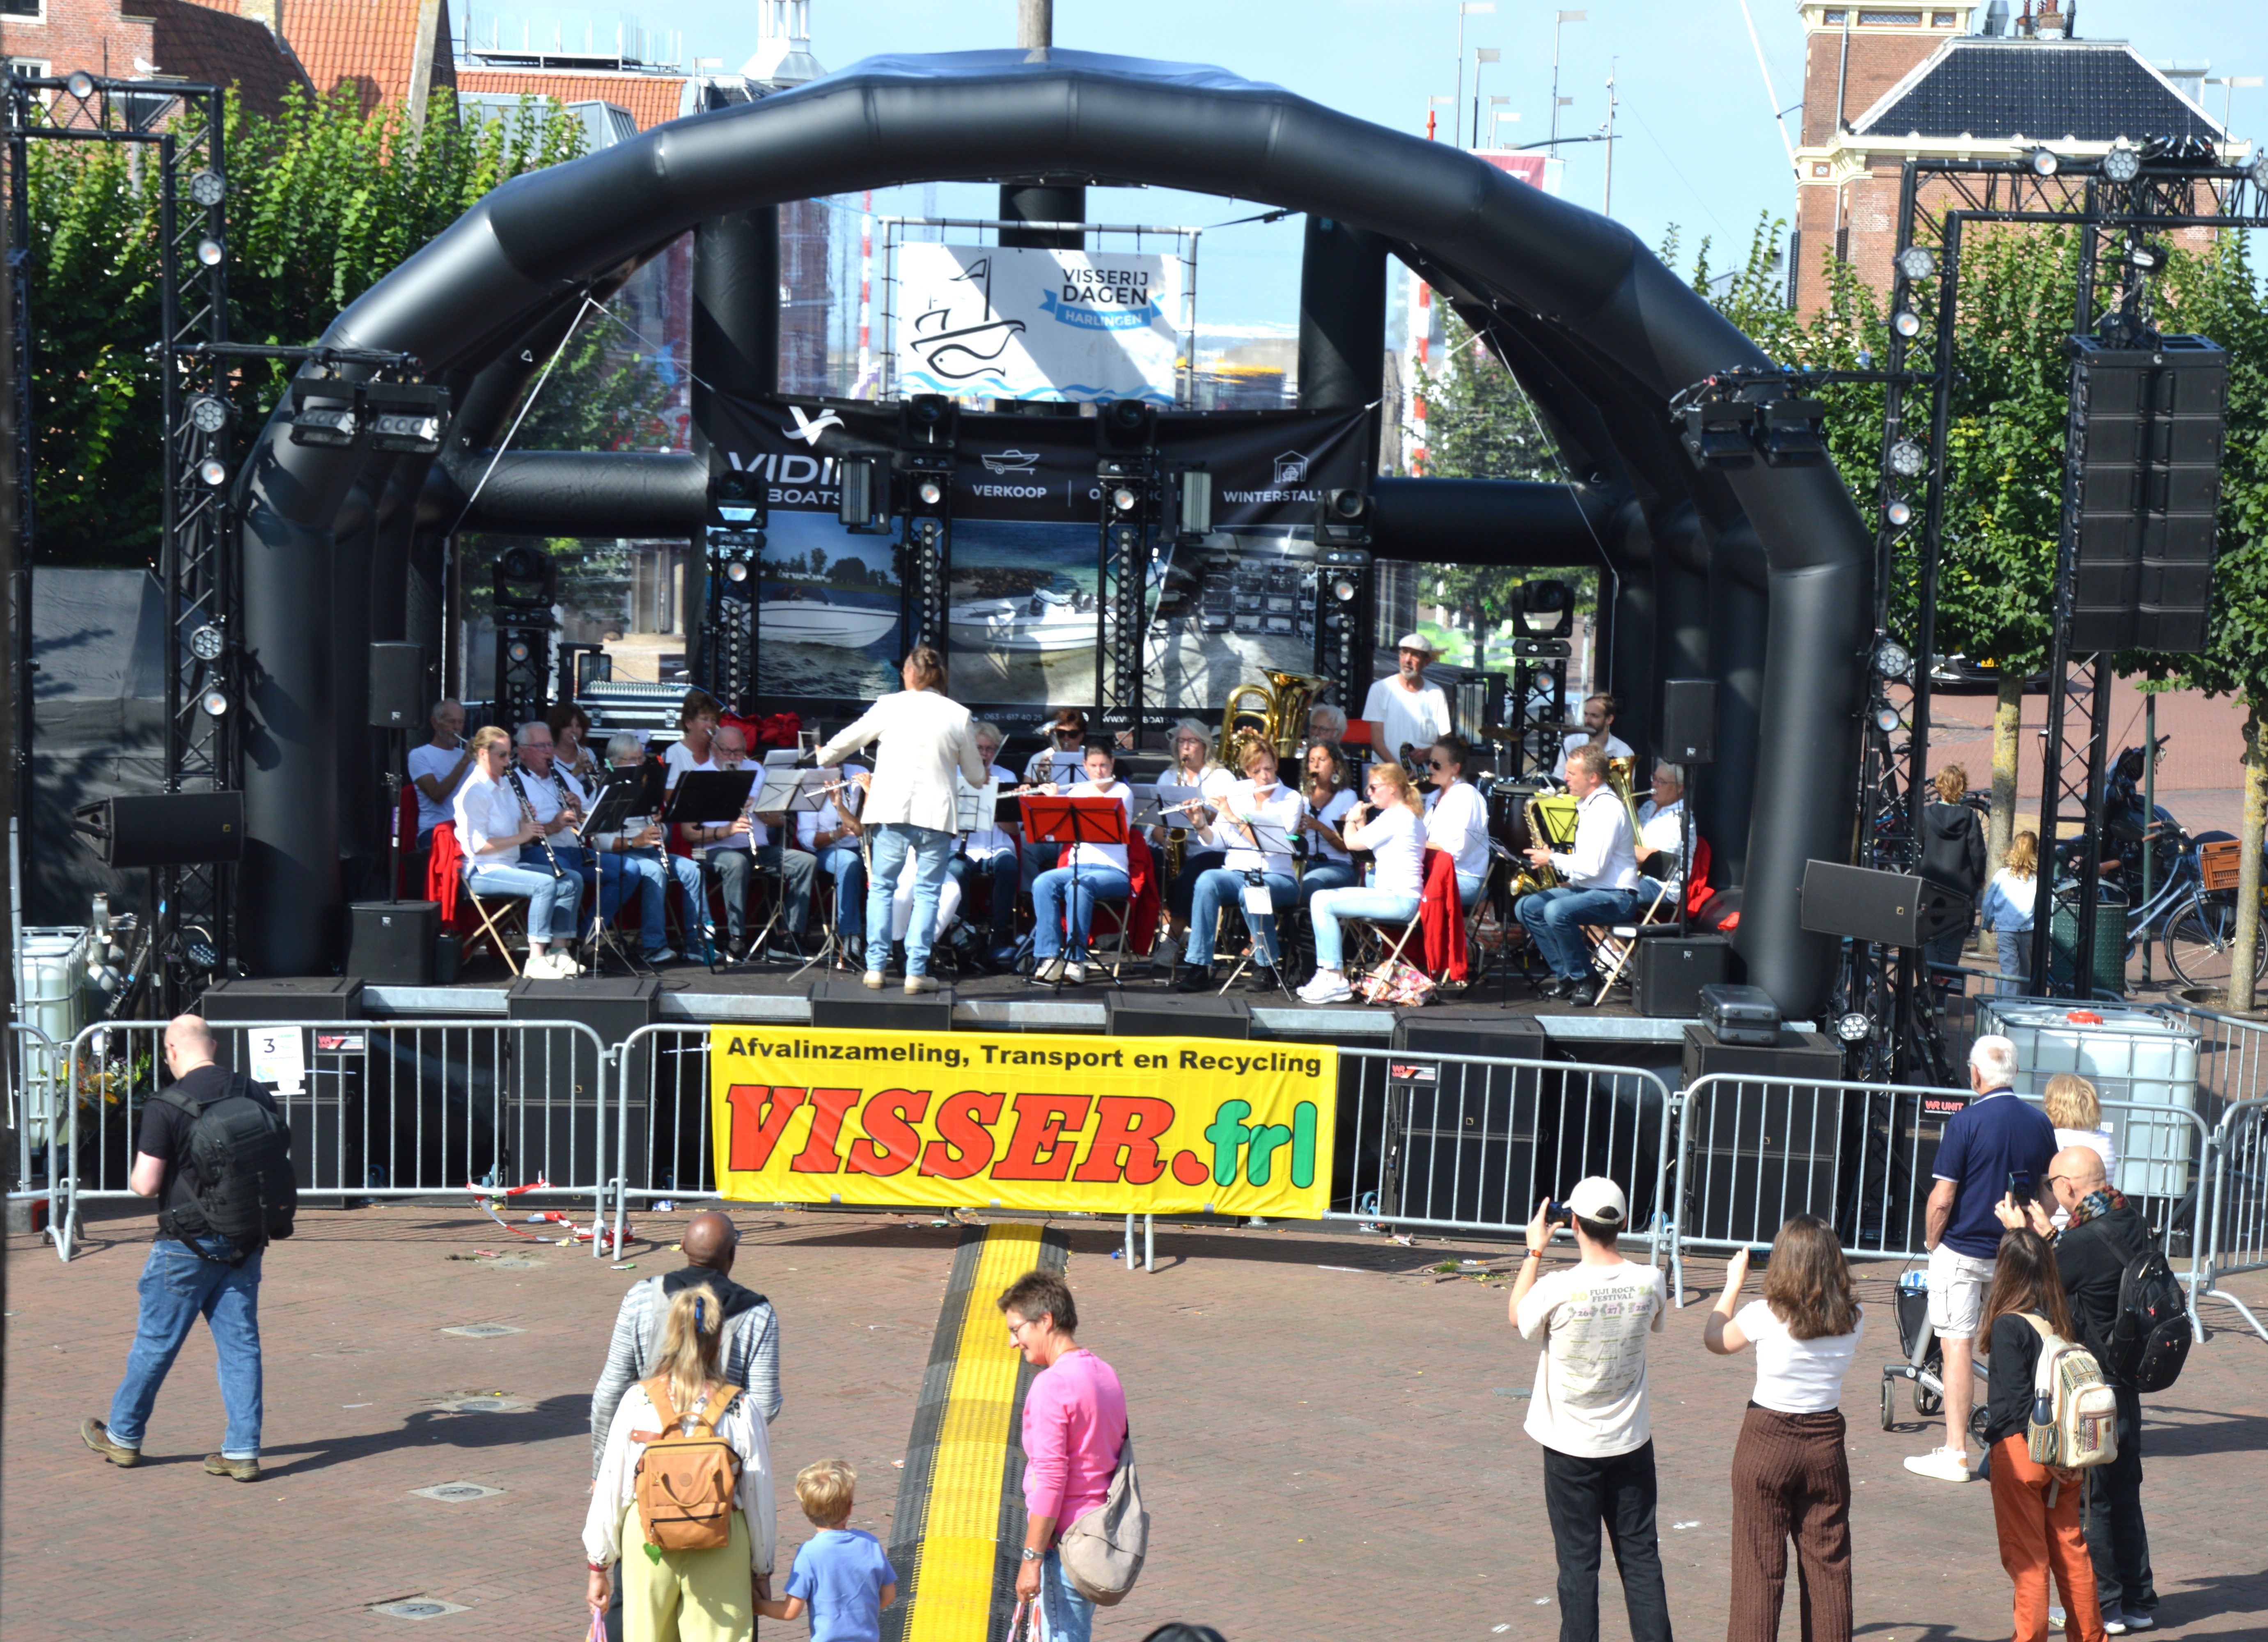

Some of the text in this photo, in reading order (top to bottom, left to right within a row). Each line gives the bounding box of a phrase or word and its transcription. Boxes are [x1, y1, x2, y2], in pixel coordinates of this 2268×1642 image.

[1062, 268, 1149, 286] VISSERIJ
[1062, 285, 1148, 305] DAGEN
[1065, 310, 1142, 327] HARLINGEN
[972, 484, 1047, 499] VERKOOP
[263, 1038, 275, 1053] 3
[727, 1037, 1321, 1077] Afvalinzameling, Transport en Recycling
[1925, 1101, 1964, 1111] WR UNIT
[1570, 1292, 1588, 1302] 20
[1590, 1288, 1609, 1296] FUJI
[1611, 1286, 1636, 1294] ROCK
[1592, 1293, 1634, 1303] FESTIVAL
